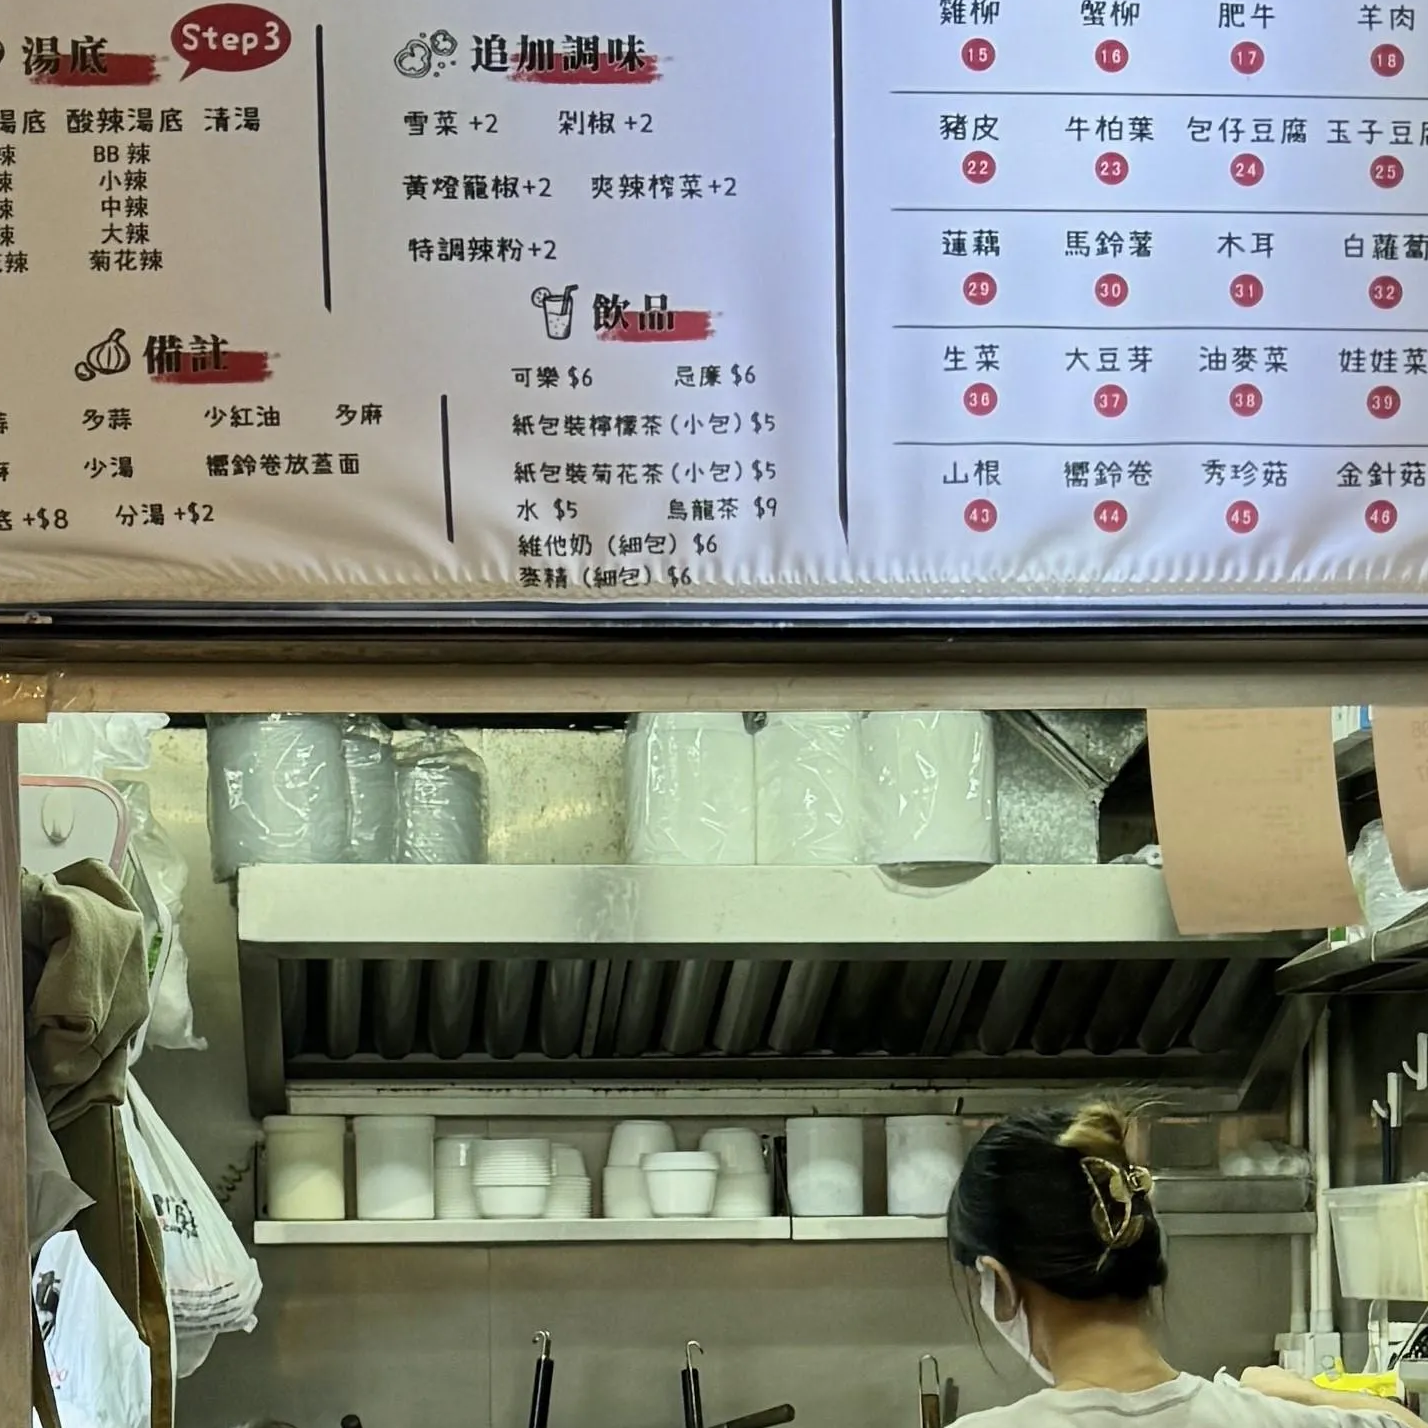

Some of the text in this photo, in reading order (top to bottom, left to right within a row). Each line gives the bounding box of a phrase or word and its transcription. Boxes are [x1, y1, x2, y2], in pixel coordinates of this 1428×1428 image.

[22, 35, 109, 75] 湯底
[471, 34, 645, 75] 追加調味
[66, 107, 183, 134] 酸辣湯底
[204, 106, 261, 133] 清湯
[403, 109, 499, 137] 雪菜 +2
[558, 110, 653, 136] 剁椒 +2
[939, 112, 999, 142] 豬皮
[1065, 115, 1155, 143] 牛柏葉
[591, 173, 737, 200] 爽辣榨菜+2
[408, 236, 557, 263] 特調辣粉+2
[1217, 231, 1275, 259] 木耳
[592, 293, 676, 334] 飲品
[143, 333, 228, 376] 備註
[510, 365, 593, 390] 可樂 $6
[204, 404, 281, 429] 少紅油
[335, 402, 383, 427] 多麻
[942, 459, 1427, 488] 山根 金針菇
[516, 497, 578, 522] 水 $5
[667, 495, 778, 522] 烏龍茶 $9
